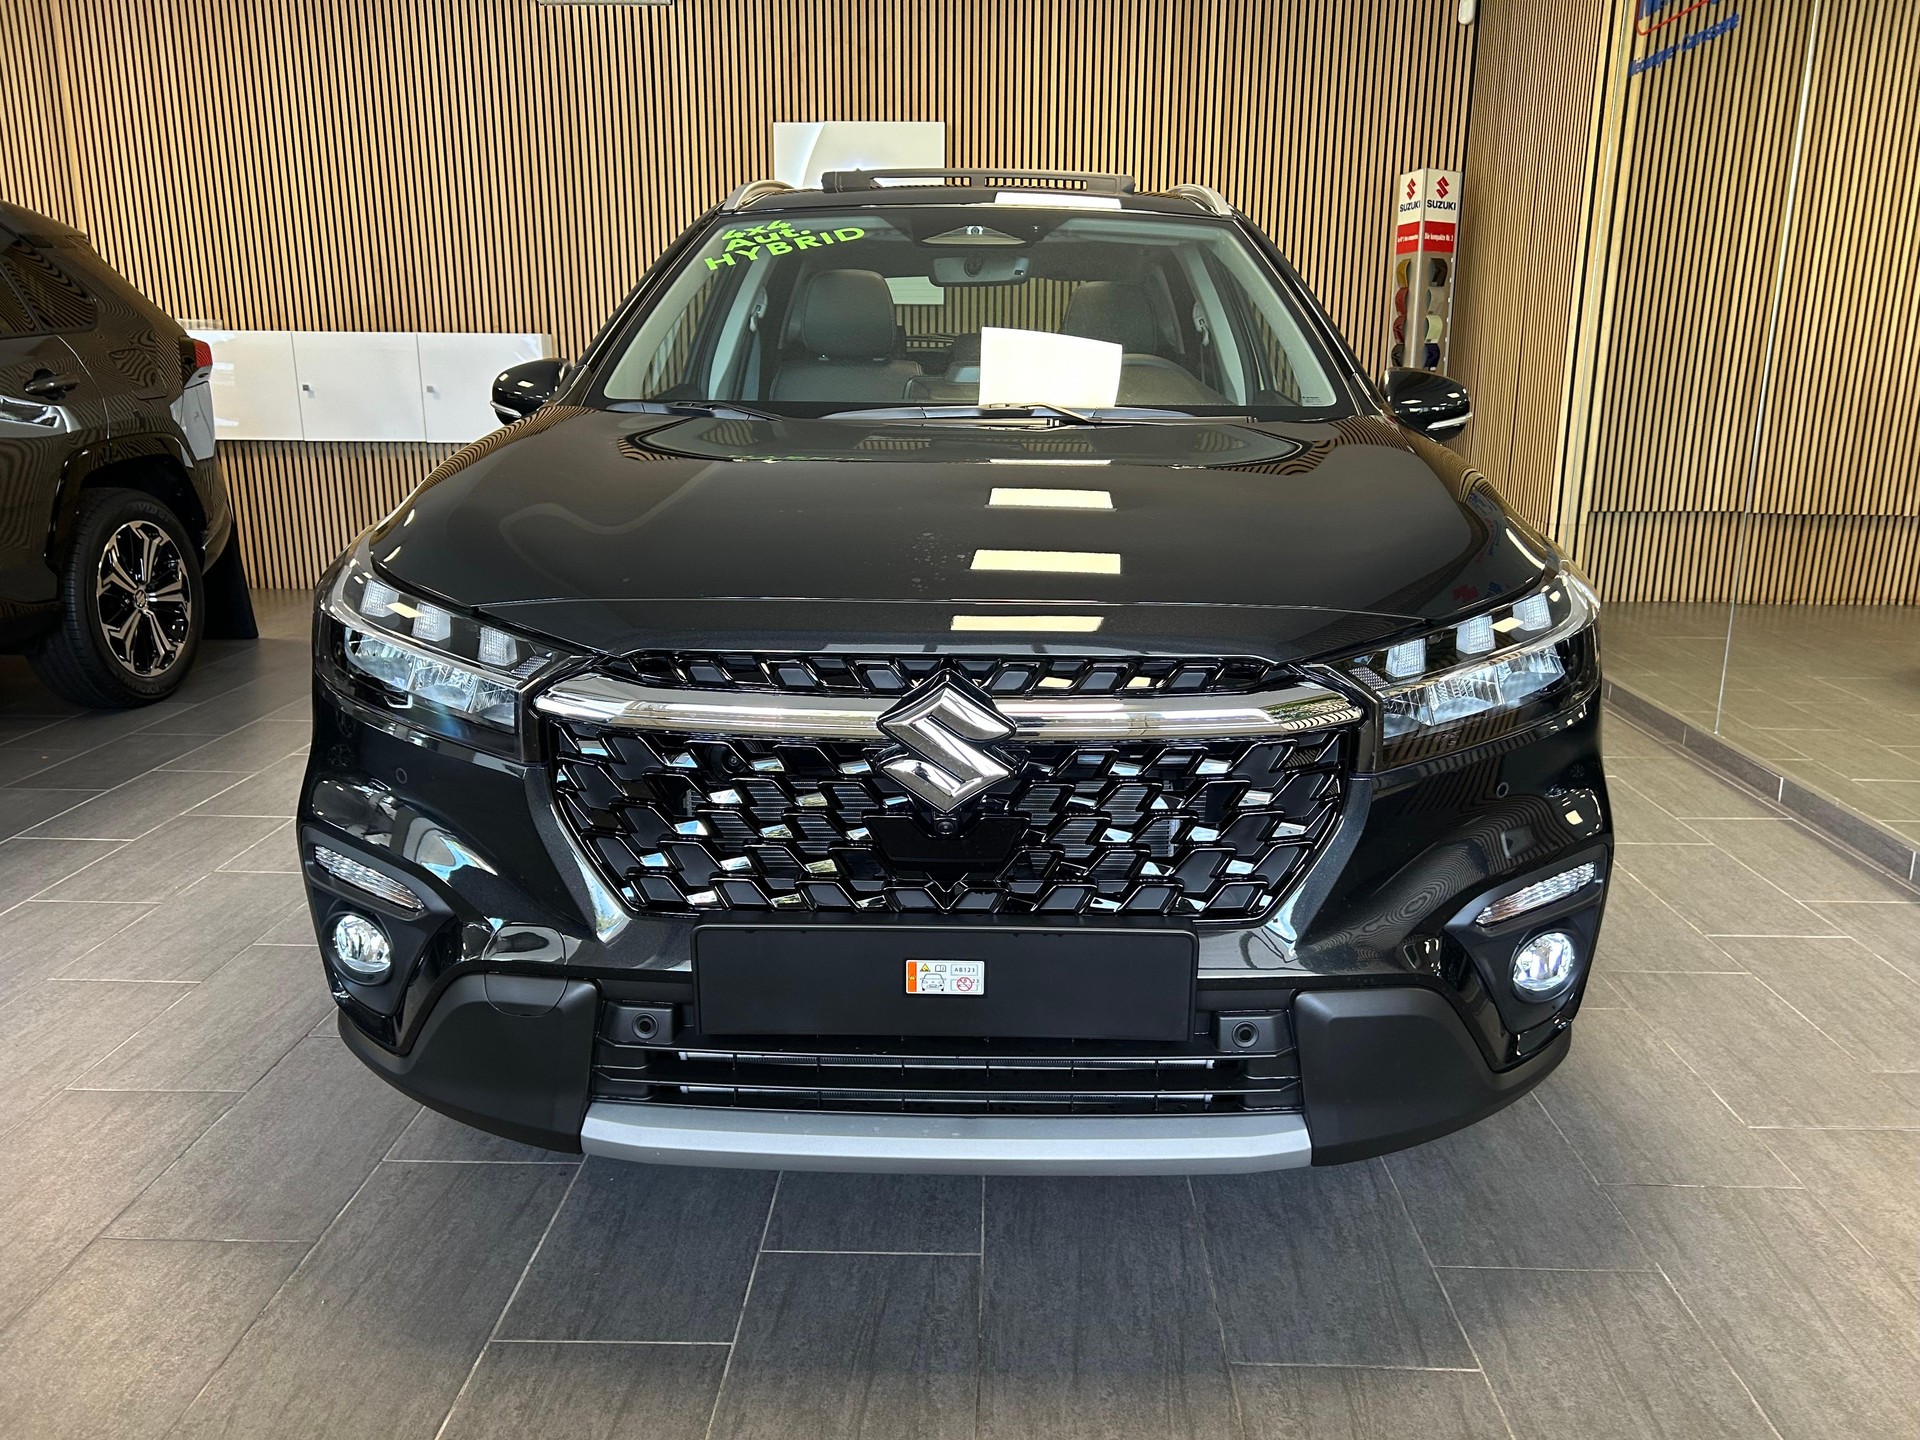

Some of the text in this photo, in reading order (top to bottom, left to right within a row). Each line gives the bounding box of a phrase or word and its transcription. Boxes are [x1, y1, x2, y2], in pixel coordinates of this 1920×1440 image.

[1400, 200, 1421, 213] SUZUKI
[1427, 199, 1456, 211] SUZUKI
[722, 220, 791, 240] 4x4
[704, 227, 865, 271] HYBRID
[725, 229, 811, 252] Aut.
